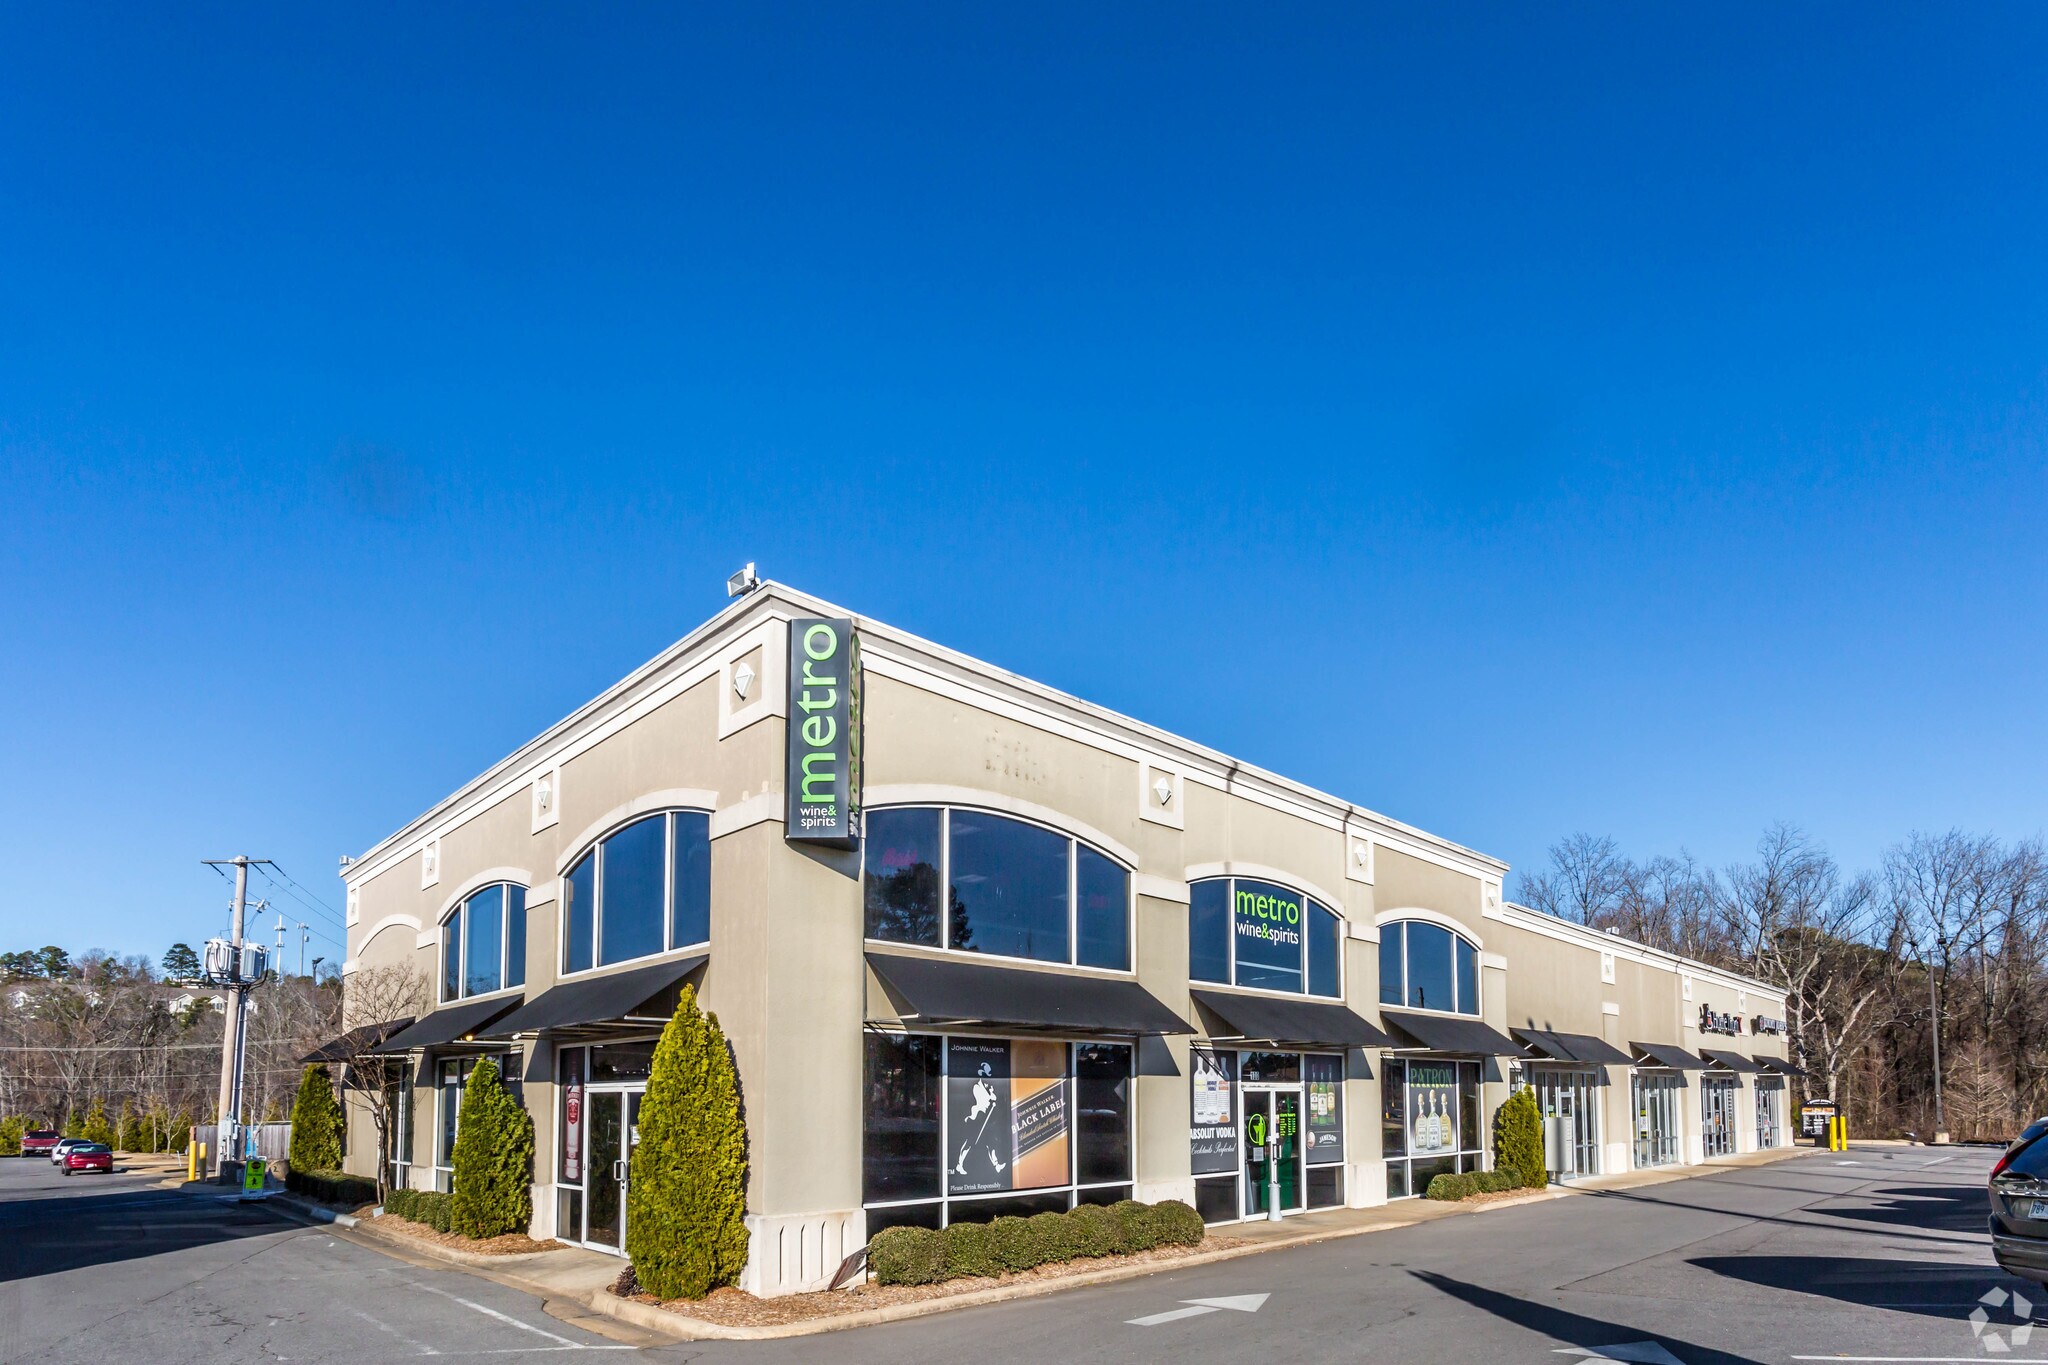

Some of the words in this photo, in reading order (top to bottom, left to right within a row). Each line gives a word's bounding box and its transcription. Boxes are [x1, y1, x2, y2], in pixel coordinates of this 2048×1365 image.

[797, 624, 838, 803] metro
[800, 804, 837, 816] wine&
[801, 815, 836, 830] spirits
[1236, 890, 1299, 925] metro
[951, 1044, 978, 1052] JOHNNIE
[979, 1045, 1004, 1053] WALKER
[1012, 1112, 1038, 1134] BLACK
[1040, 1098, 1066, 1118] LABEL
[1216, 1127, 1236, 1138] VODKA
[963, 1183, 977, 1191] Drink
